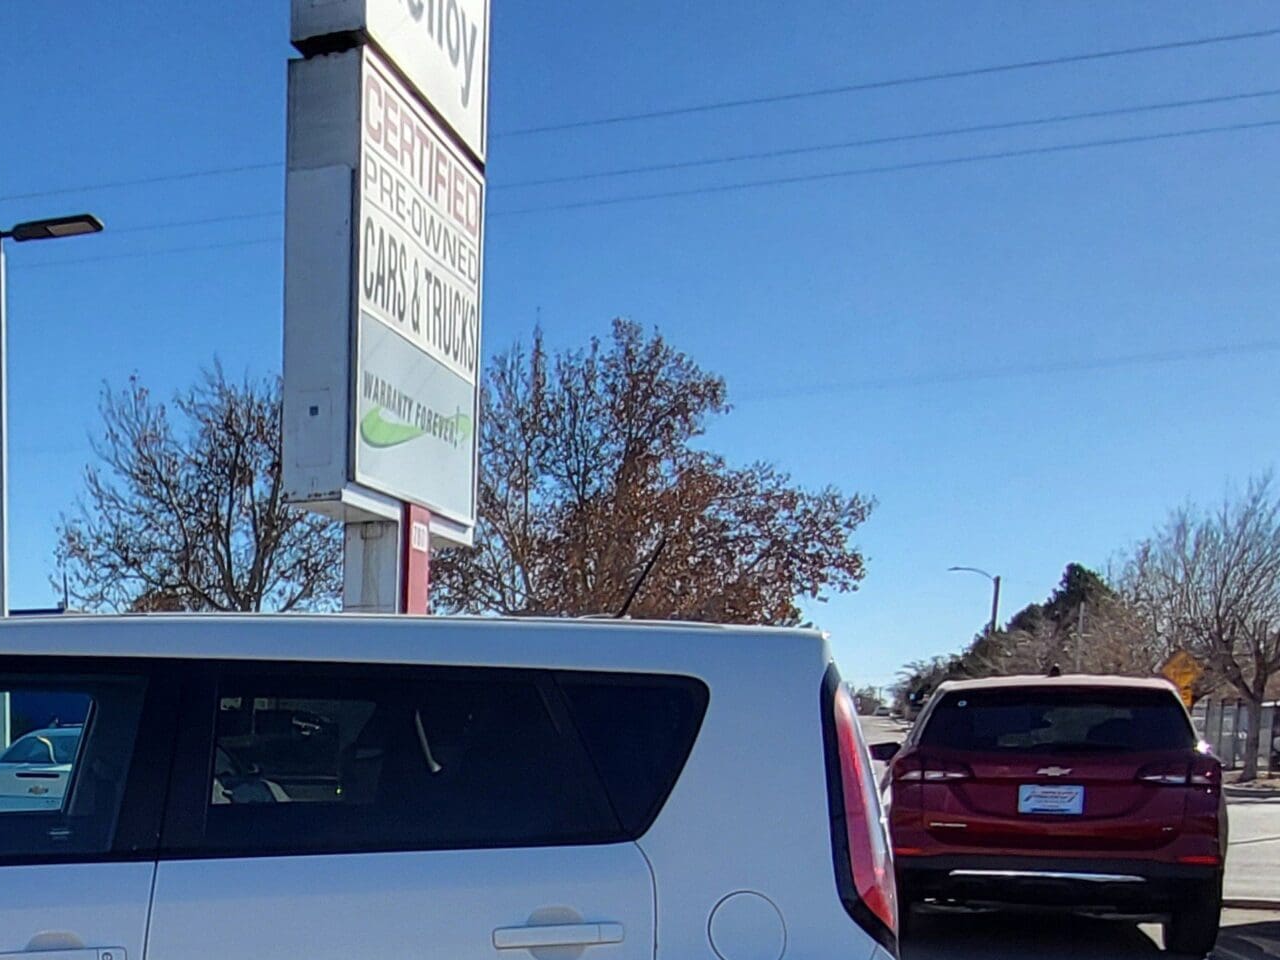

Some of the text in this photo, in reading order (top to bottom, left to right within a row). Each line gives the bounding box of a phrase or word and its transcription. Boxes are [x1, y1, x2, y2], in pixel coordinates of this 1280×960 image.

[364, 74, 478, 238] CERTIFIED
[364, 150, 477, 285] PRE-OWNED
[363, 216, 476, 373] CARS & TRUCKS
[363, 370, 414, 424] WARRANTY
